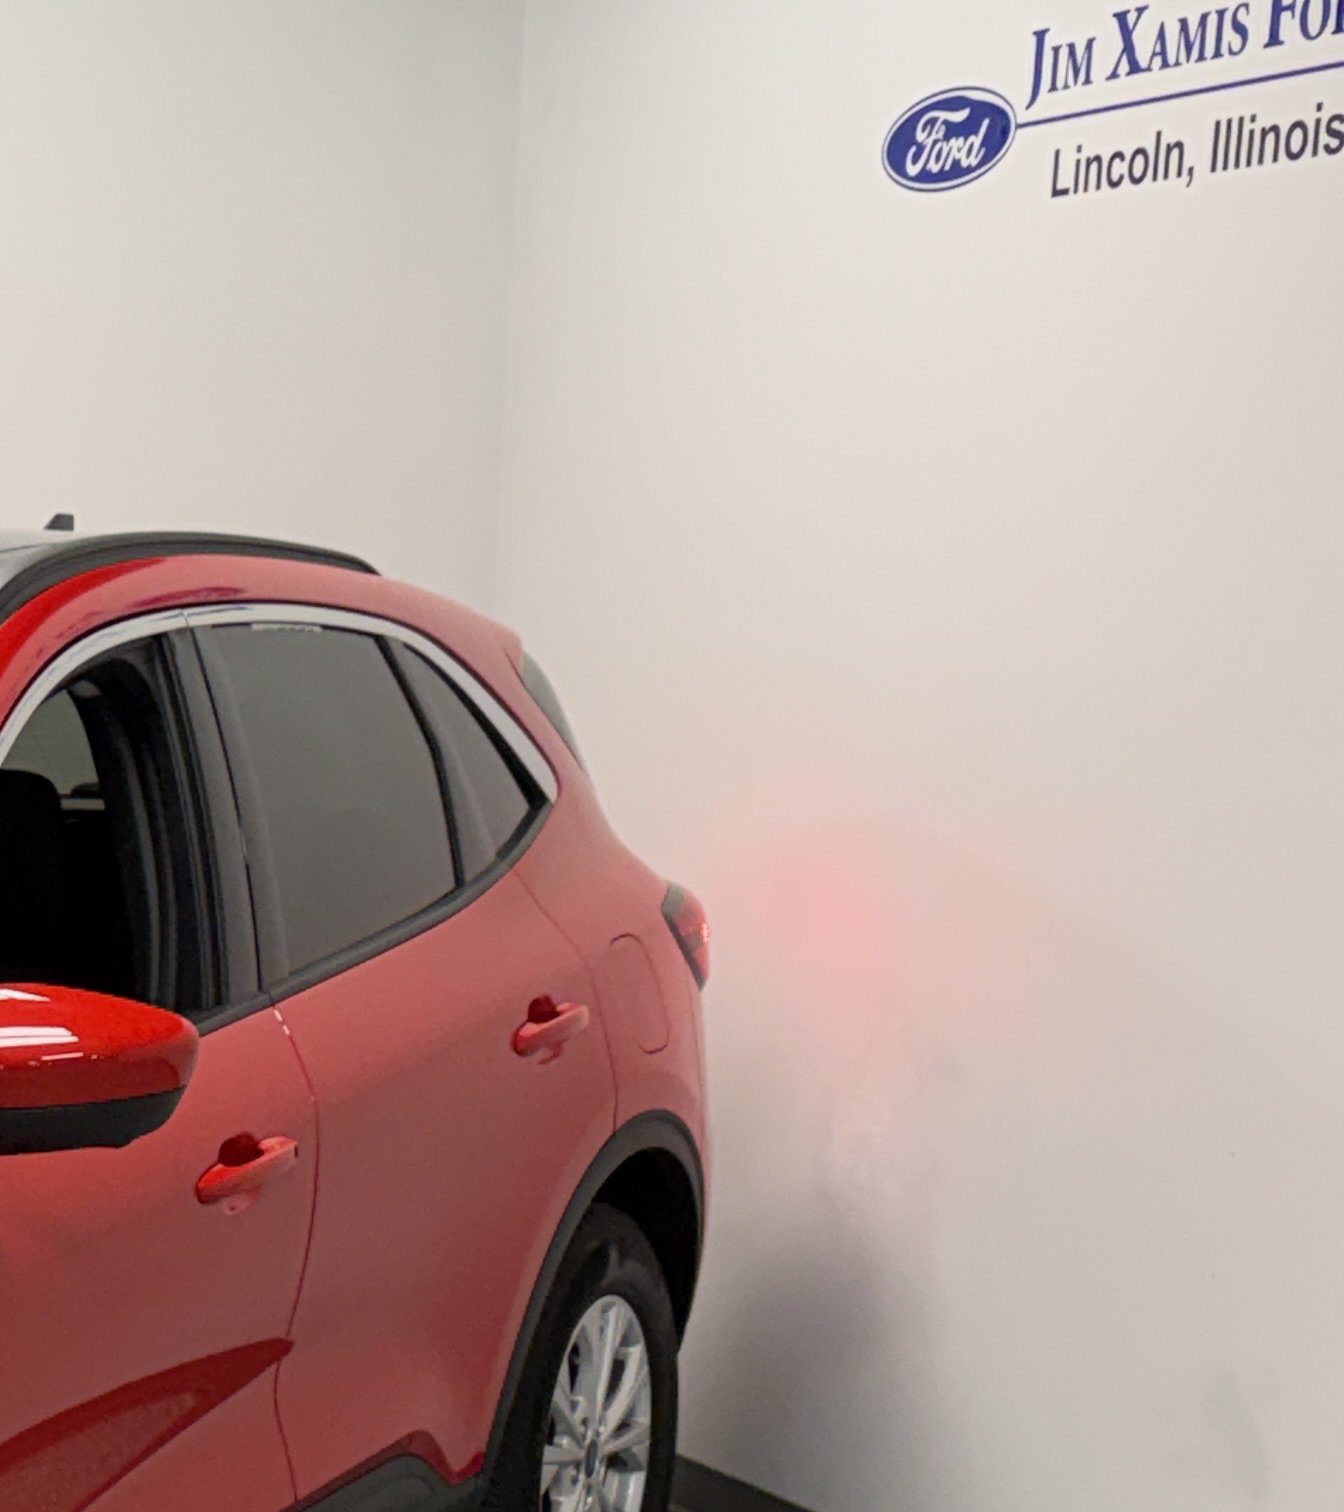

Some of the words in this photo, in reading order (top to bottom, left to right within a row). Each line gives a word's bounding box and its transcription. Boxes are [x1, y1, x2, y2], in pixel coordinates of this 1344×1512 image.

[1025, 28, 1097, 110] JIM
[1106, 2, 1250, 82] XAMIS
[906, 107, 990, 177] Ford
[1050, 130, 1194, 198] Lincoln,
[1210, 102, 1344, 173] Illinois
